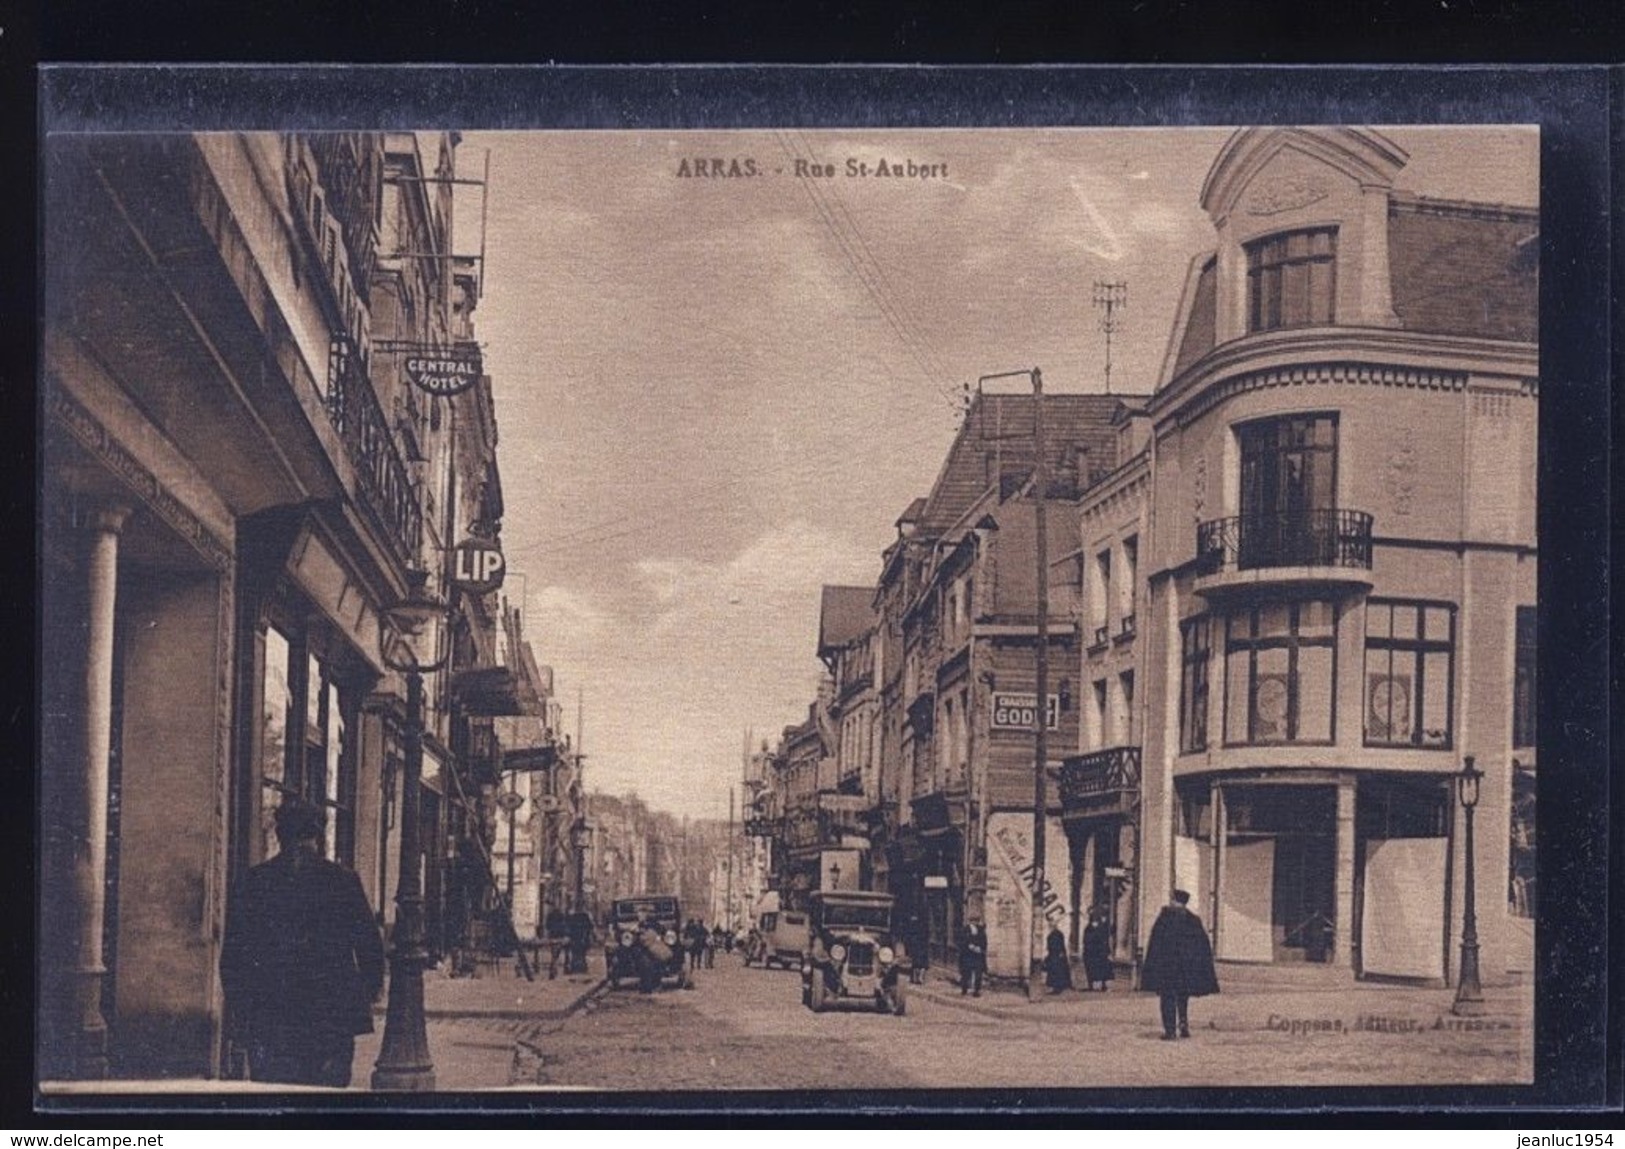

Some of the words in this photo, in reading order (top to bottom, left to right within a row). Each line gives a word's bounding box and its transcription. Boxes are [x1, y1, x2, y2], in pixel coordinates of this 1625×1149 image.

[407, 359, 477, 375] CENTRAL
[419, 372, 467, 390] HOTEL
[456, 549, 503, 582] LIP
[996, 707, 1054, 726] GODT
